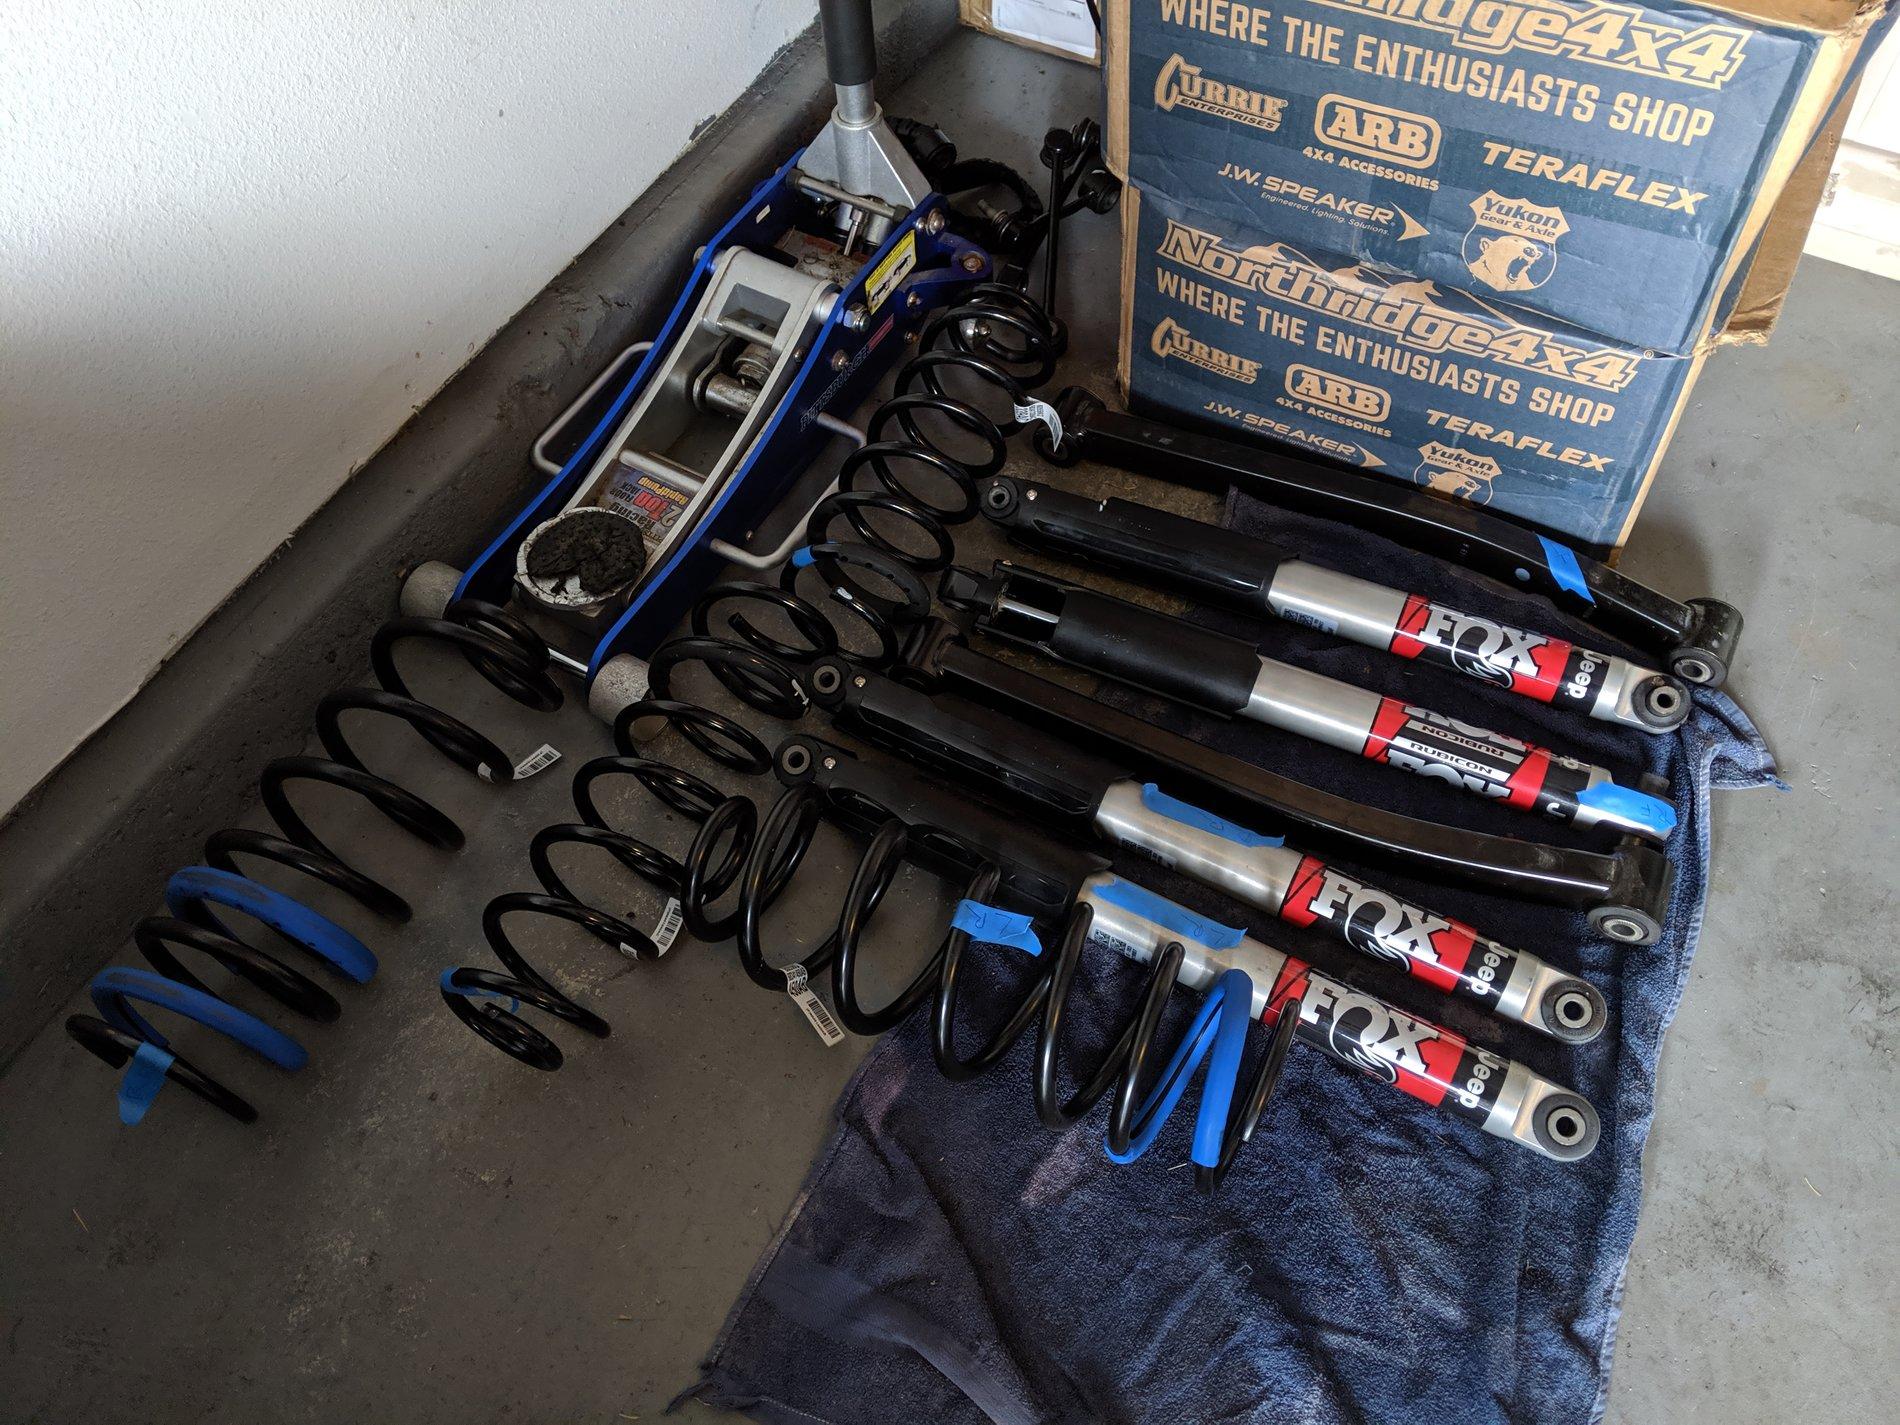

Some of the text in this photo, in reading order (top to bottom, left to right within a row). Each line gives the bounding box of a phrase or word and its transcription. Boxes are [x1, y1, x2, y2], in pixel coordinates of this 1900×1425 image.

[1154, 53, 1289, 121] CURRIE
[1160, 0, 1715, 147] WHERE THE ENTHUSIASTS SHOP
[1179, 97, 1276, 130] ENTERPRISES
[1326, 105, 1428, 158] ARB
[1218, 163, 1395, 226] J.W. SPEAKER
[1302, 146, 1440, 192] 4X4 ACCESSORIES
[1483, 141, 1709, 215] TERAFLEX
[1261, 191, 1391, 236] Engineered. Lighting. Solutions.
[1479, 212, 1556, 239] Gear & Axle
[1484, 197, 1560, 229] Yukon
[1157, 218, 1638, 393] Northridge4x4
[1151, 317, 1262, 378] CURRIE
[1156, 267, 1616, 427] WHERE THE ENTHUSIASTS SHOP
[1172, 349, 1252, 383] ENTERPRISES
[1275, 396, 1392, 438] 4X4 ACCESSORIES
[1295, 371, 1380, 416] ARB
[1204, 401, 1356, 456] J.W. SPEAKER
[1426, 409, 1615, 472] TERAFLEX
[1426, 454, 1453, 467] Gear
[1464, 465, 1490, 477] Axle
[1430, 446, 1493, 471] Yukon
[1417, 603, 1548, 681] FOX
[1567, 648, 1603, 699] Jeep
[1410, 742, 1493, 775] RUBICON
[1421, 725, 1505, 758] RUBICON
[1309, 869, 1452, 968] FOX
[1470, 941, 1512, 996] Jeep
[1300, 972, 1440, 1079] FOX
[1459, 1046, 1502, 1109] Jeep
